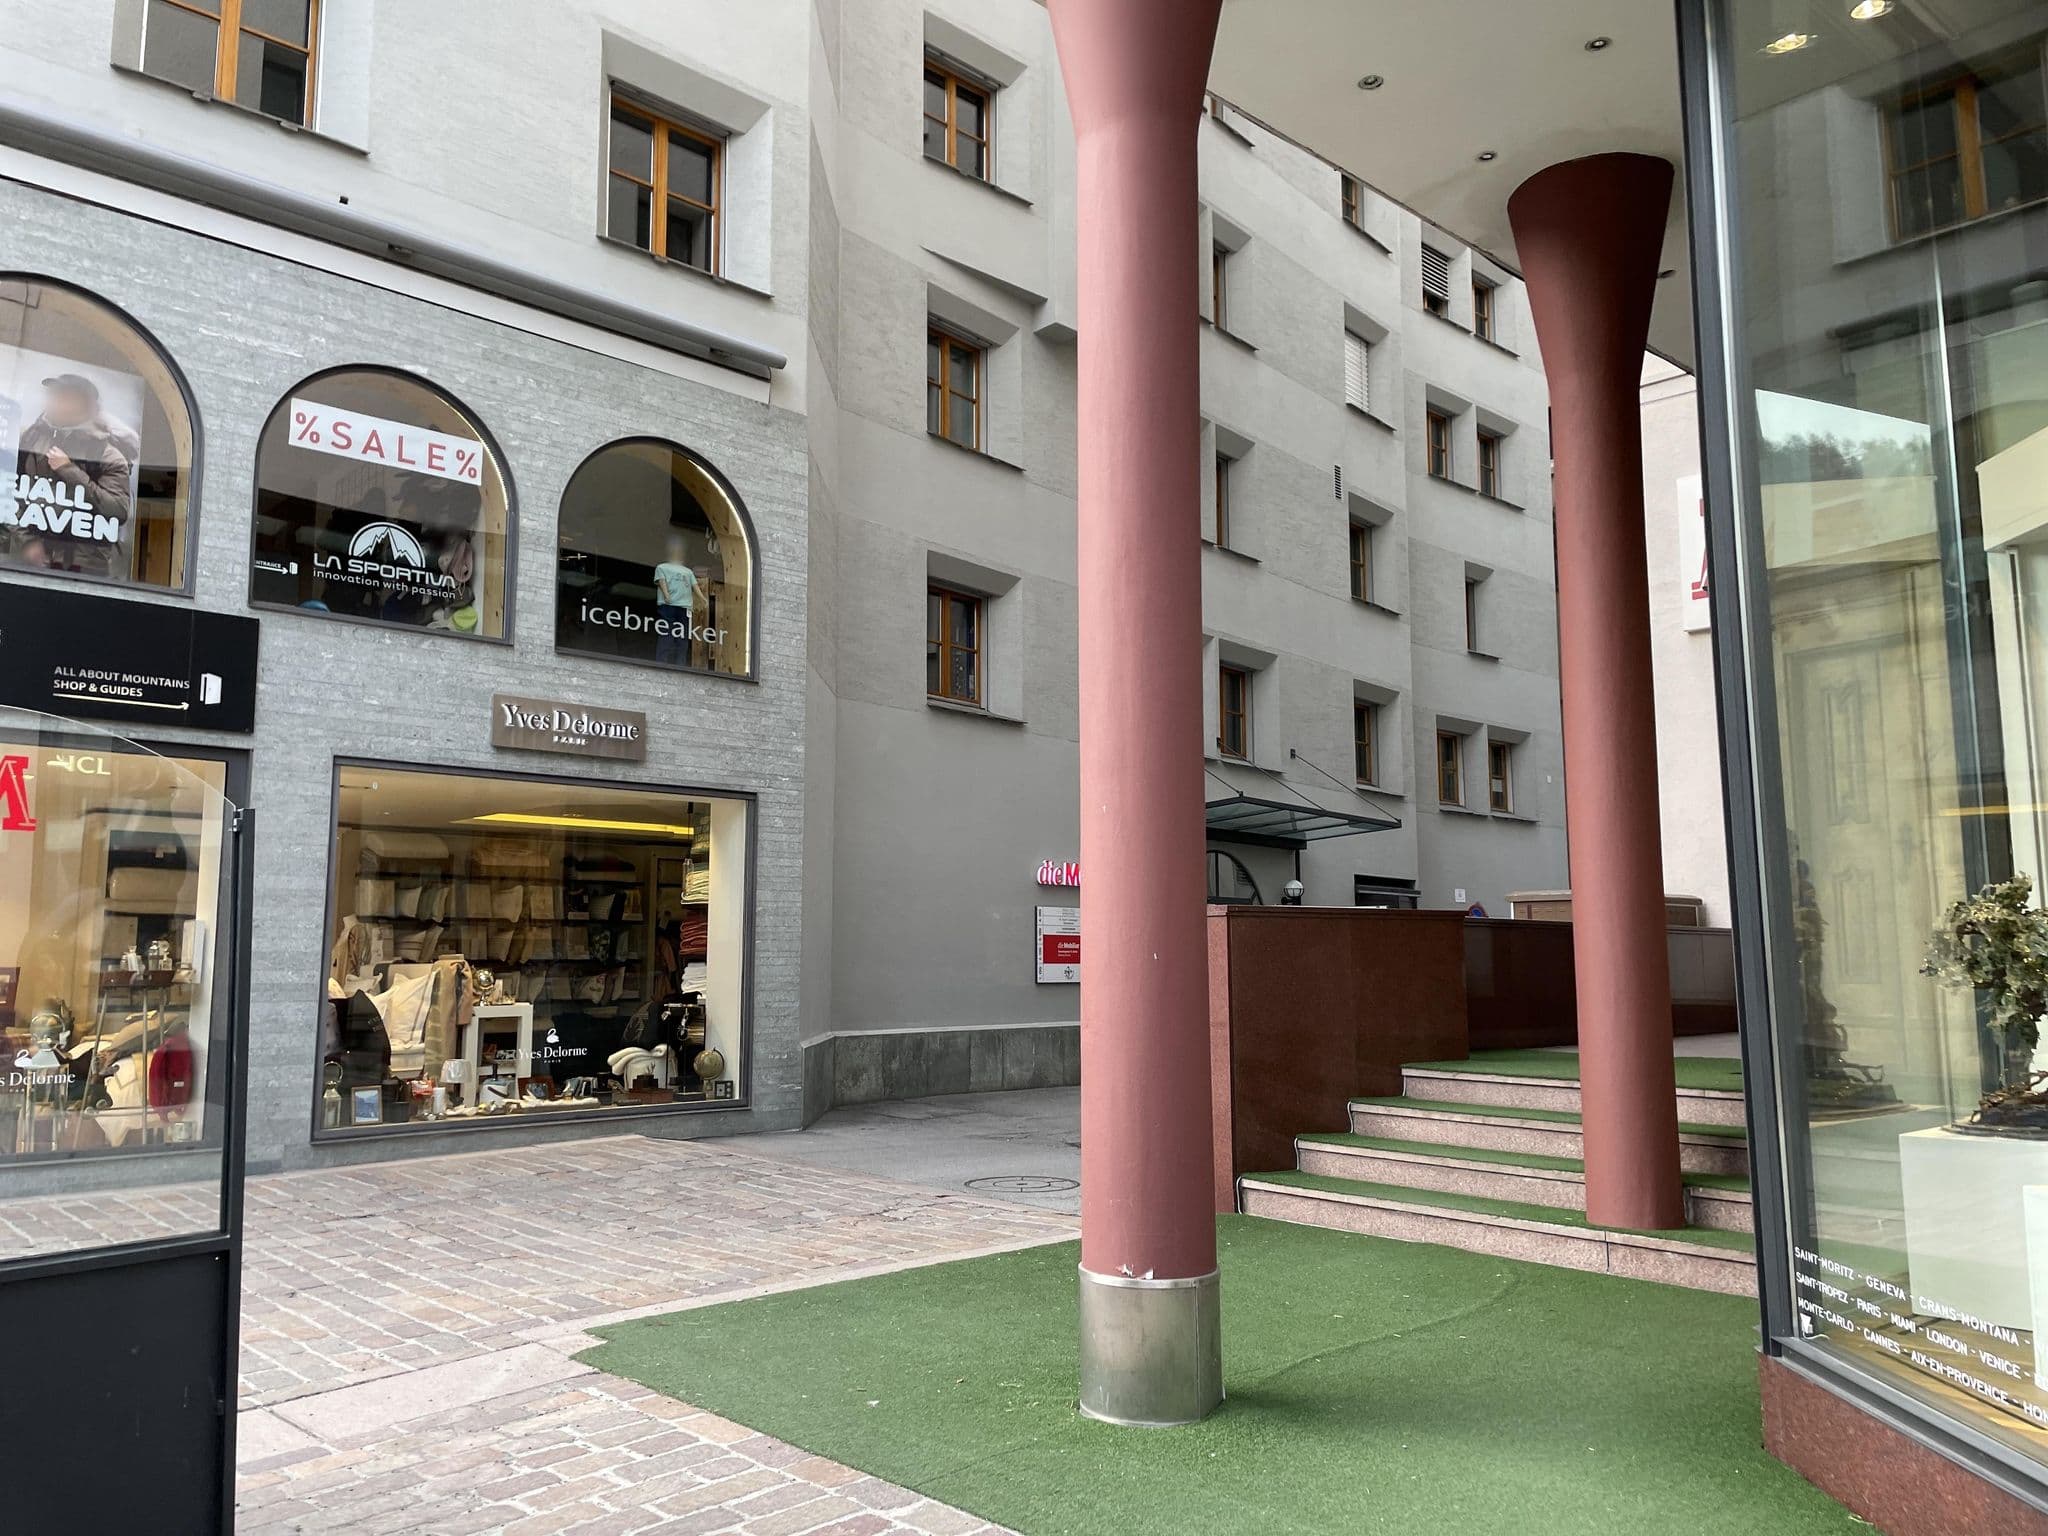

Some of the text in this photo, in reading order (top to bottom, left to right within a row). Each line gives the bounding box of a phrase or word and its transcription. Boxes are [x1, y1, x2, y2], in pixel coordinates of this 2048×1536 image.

[313, 568, 456, 599] innovation with passion
[314, 552, 456, 588] LA SPORTIVA
[581, 597, 728, 645] icebreaker
[53, 679, 143, 697] SHOP & GUIDES
[54, 666, 190, 689] ALL ABOUT MOUNTAINS
[501, 703, 640, 740] Yves Delorme
[544, 1046, 588, 1059] Delorme
[1794, 1247, 1854, 1280] SAINT-MORITZ
[1866, 1275, 1906, 1301] GENEVA
[1919, 1296, 2020, 1346] CRANS-MONTANA
[1796, 1271, 1848, 1304] SAINT-TROPEZ
[1857, 1298, 1881, 1318] PARIS
[1891, 1312, 1916, 1333] MIAMI
[1926, 1327, 1968, 1356] LONDON
[1979, 1350, 2021, 1380] VENICE
[1798, 1297, 1854, 1332] MONTE-CARLO
[1864, 1328, 1901, 1354] CANNES
[1911, 1350, 2009, 1405] AIX-EN-PROVENCE
